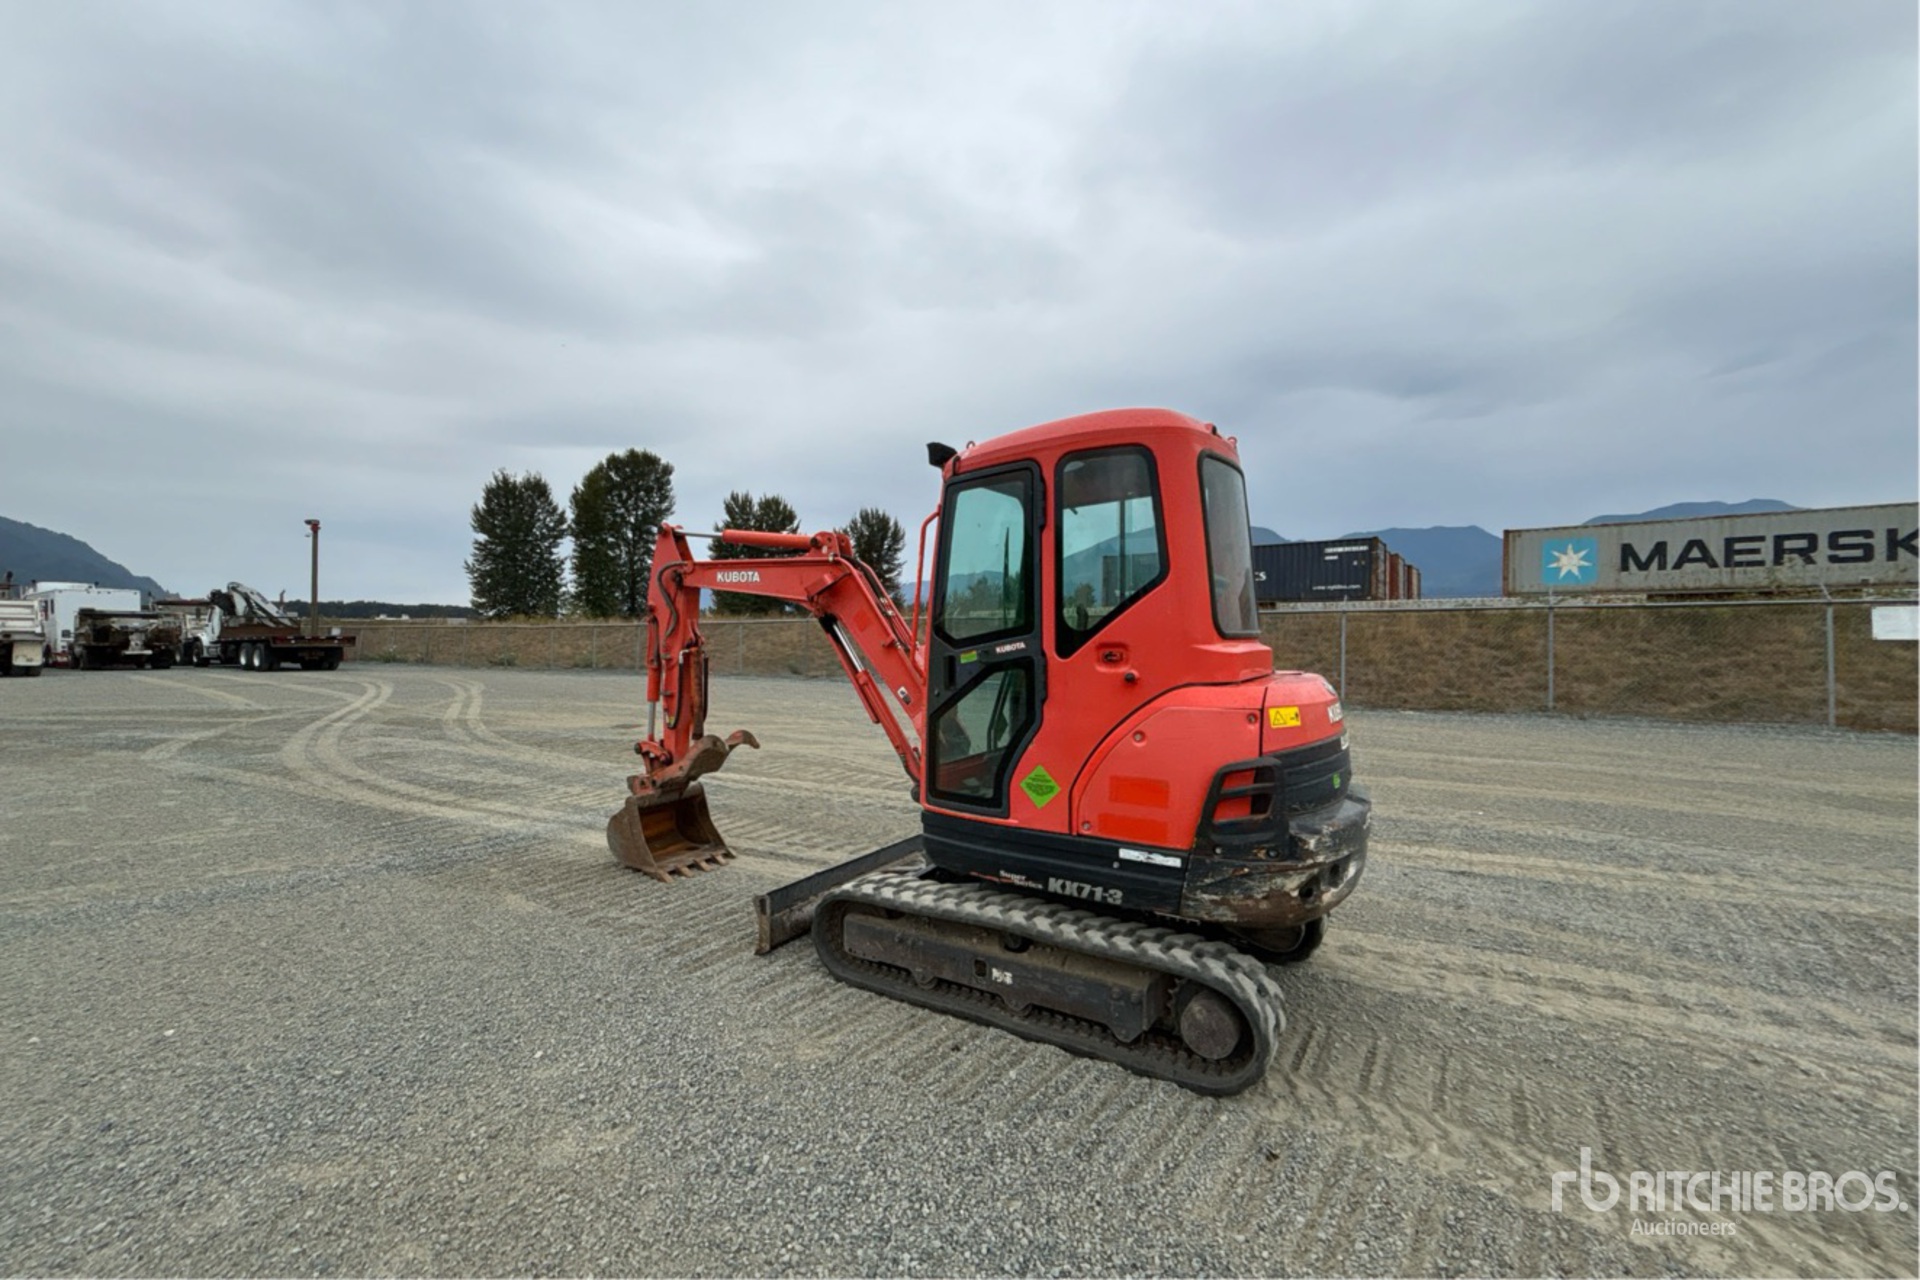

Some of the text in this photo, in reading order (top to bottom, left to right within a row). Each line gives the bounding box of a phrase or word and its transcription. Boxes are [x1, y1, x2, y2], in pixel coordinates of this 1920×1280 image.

[1620, 528, 1919, 572] MAERSK
[717, 571, 760, 582] KUBOTA
[995, 641, 1026, 654] KUBOTA
[1048, 877, 1124, 905] KX71-3
